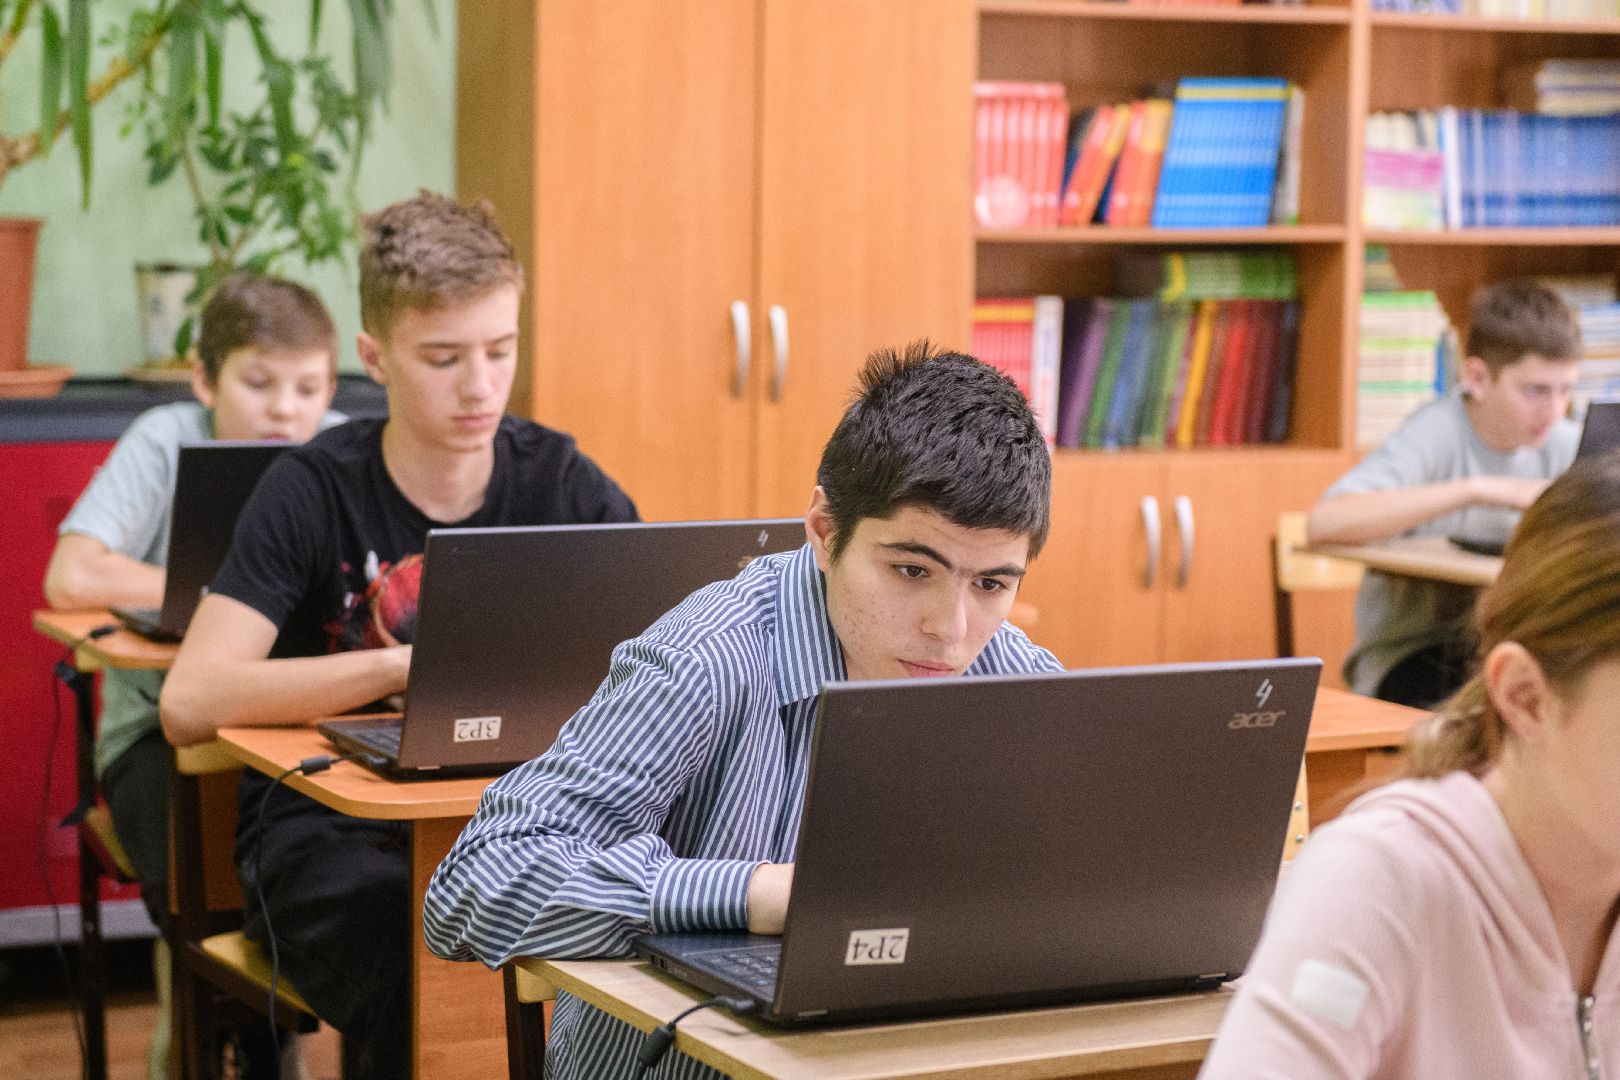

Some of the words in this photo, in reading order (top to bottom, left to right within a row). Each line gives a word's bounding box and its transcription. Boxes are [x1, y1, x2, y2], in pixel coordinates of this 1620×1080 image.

[458, 720, 497, 739] 3P2
[1229, 711, 1286, 729] acer
[853, 935, 904, 960] 2P4
